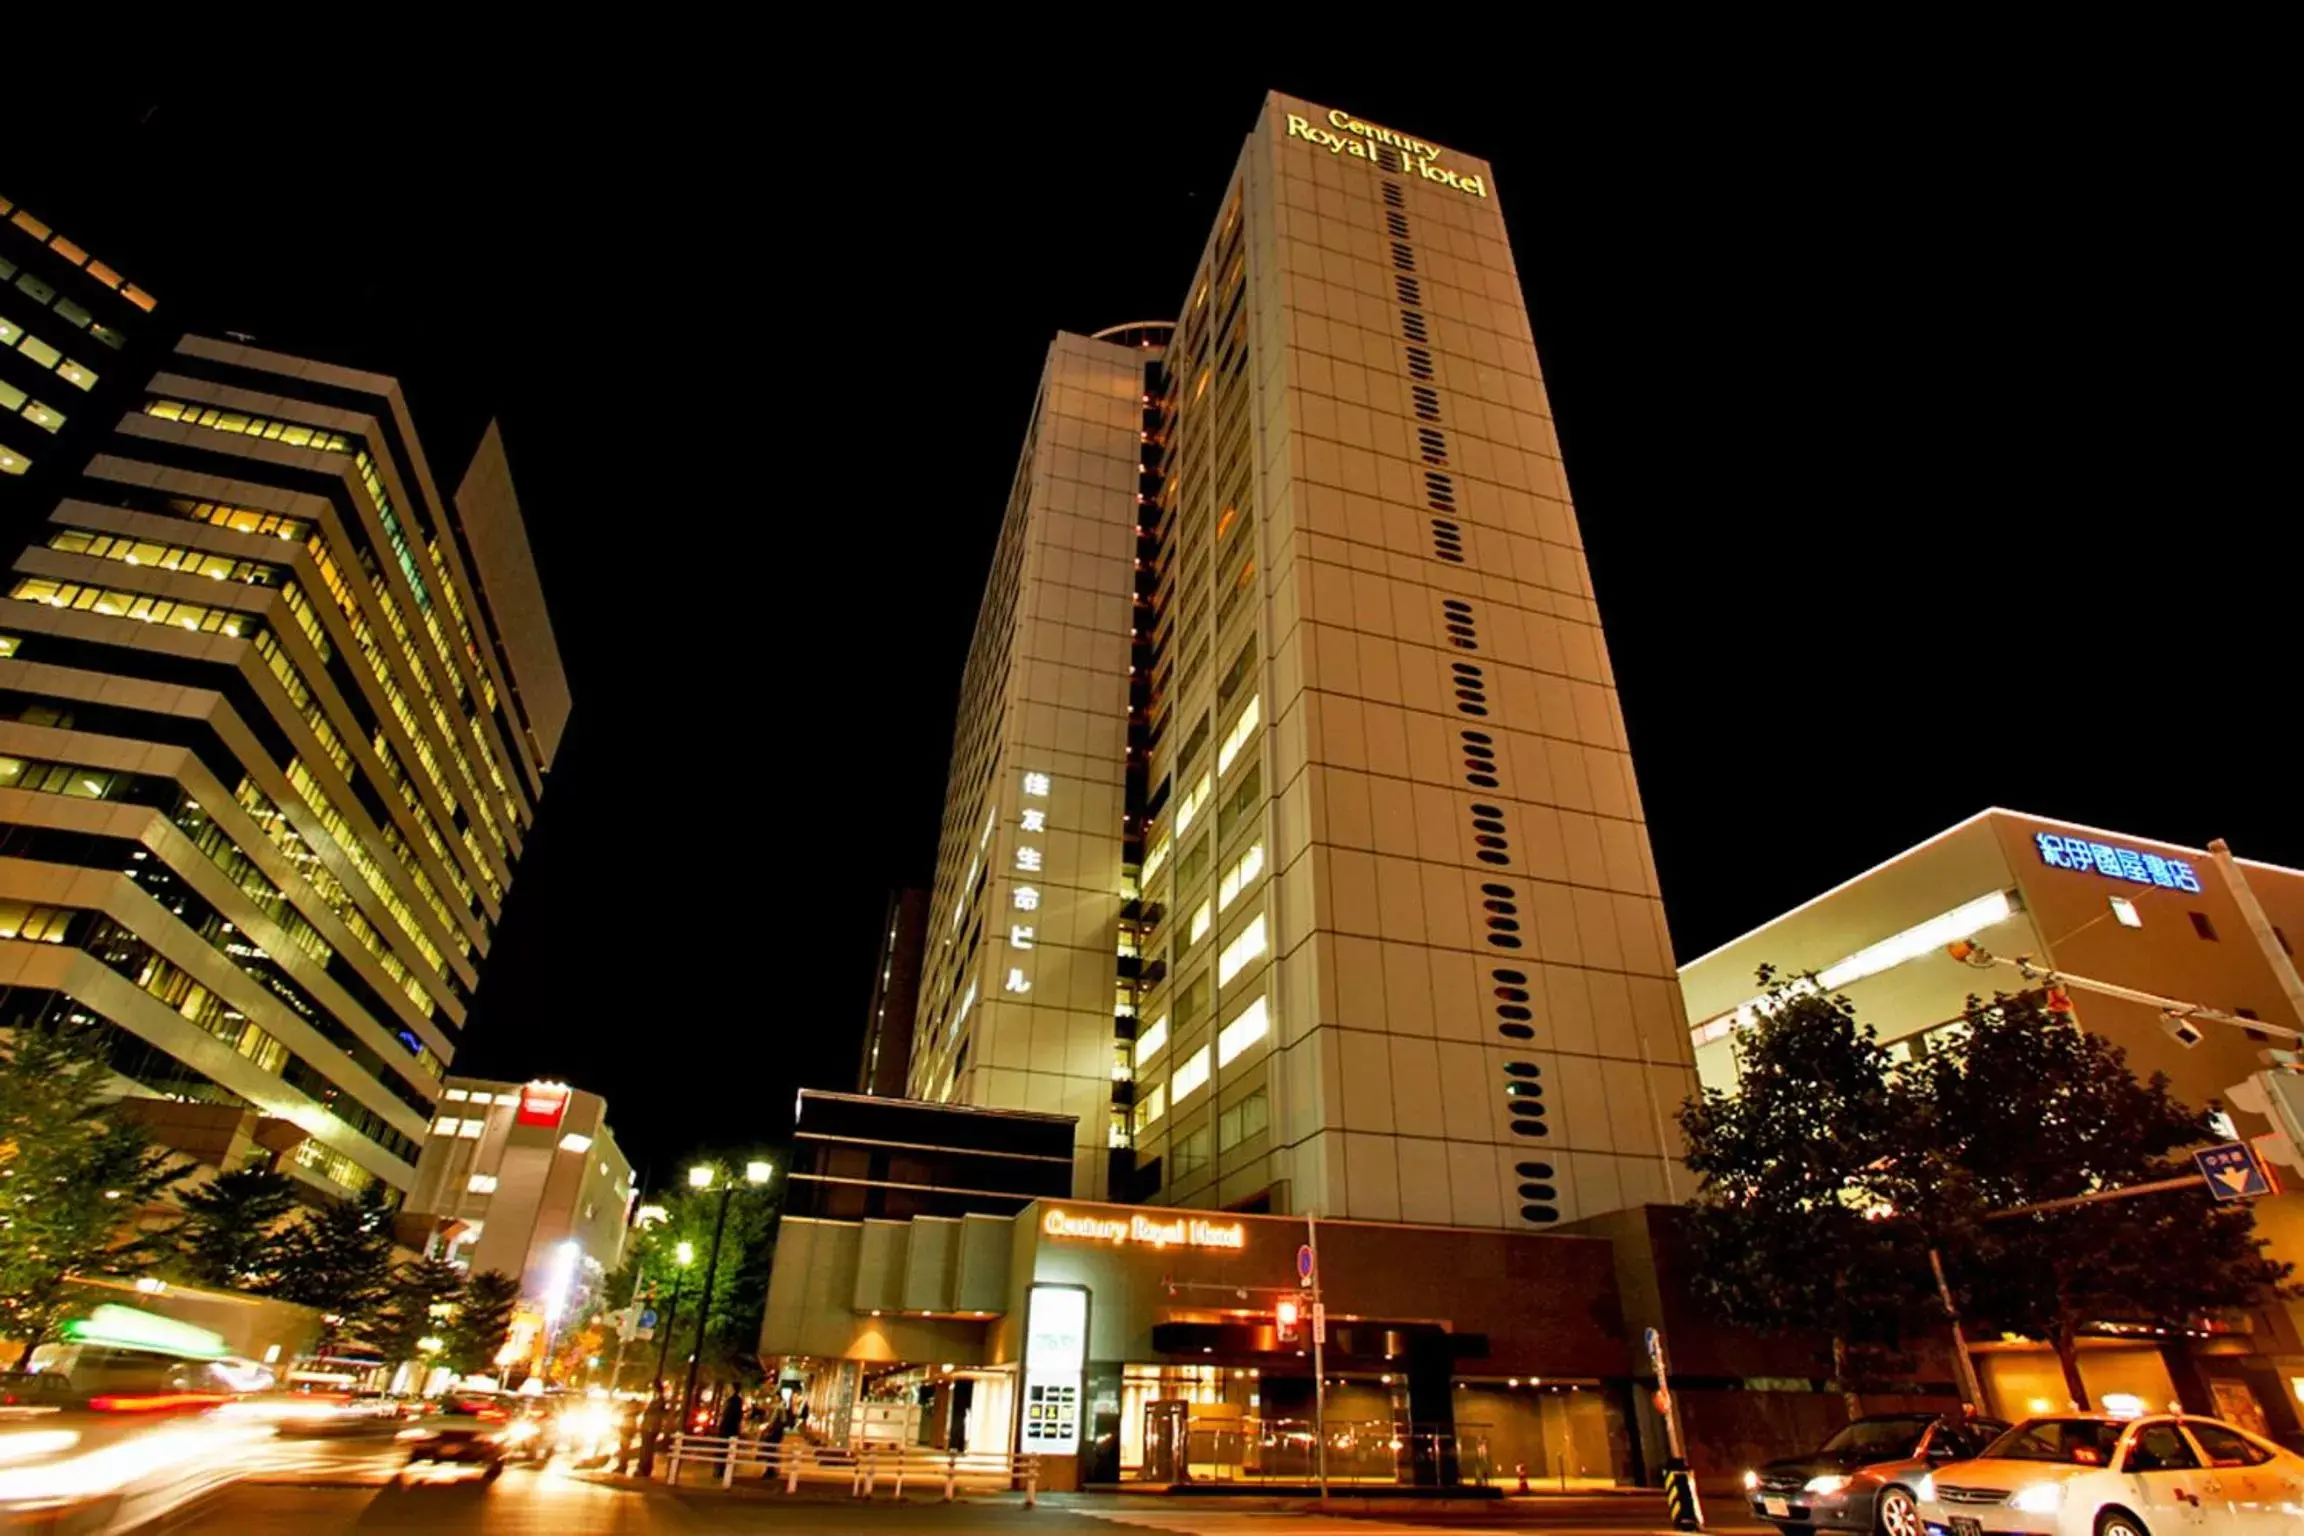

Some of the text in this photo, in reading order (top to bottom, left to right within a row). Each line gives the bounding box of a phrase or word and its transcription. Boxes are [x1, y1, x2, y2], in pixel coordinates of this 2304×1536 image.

[1286, 113, 1487, 198] Royal Hotel
[1328, 109, 1441, 160] Century
[1005, 772, 1050, 993] 住友生命ビル
[2036, 832, 2200, 893] 紀伊國屋書店
[1044, 1209, 1129, 1245] Century
[1131, 1215, 1186, 1249] Royal
